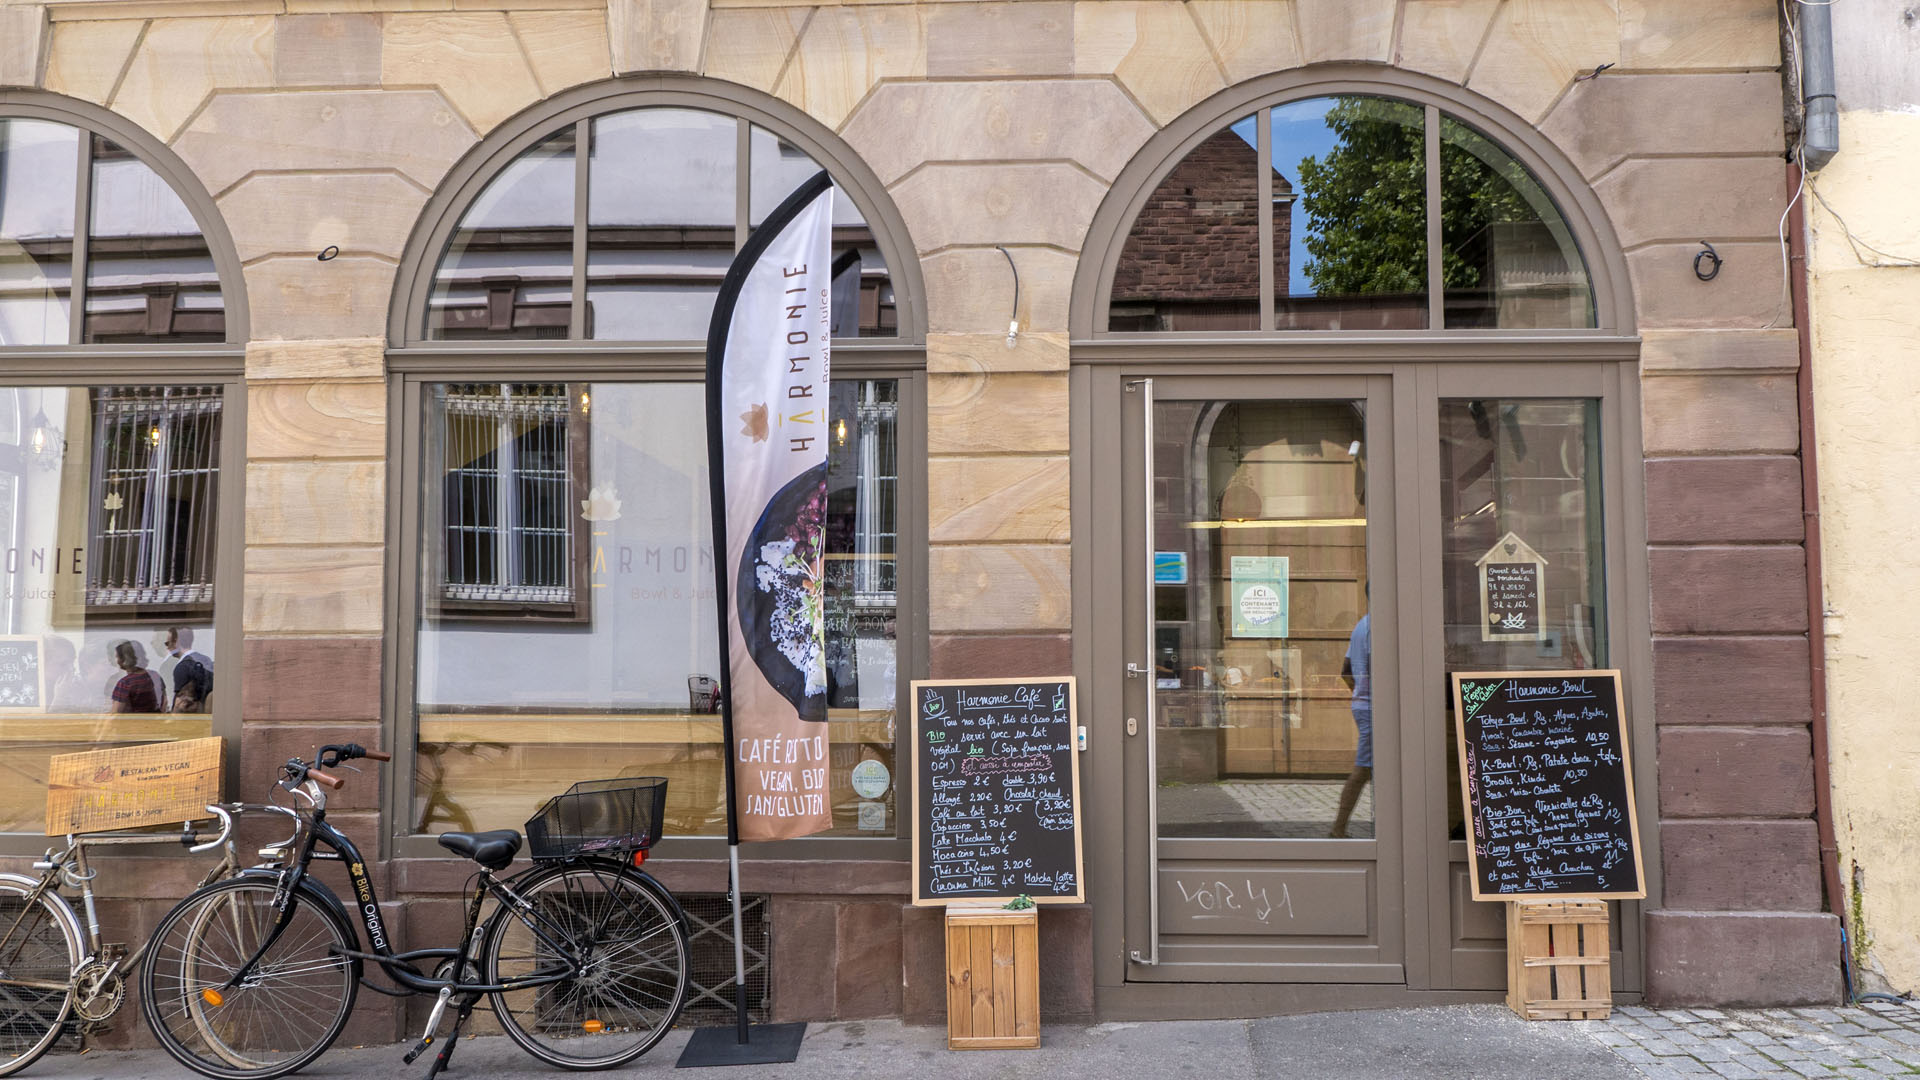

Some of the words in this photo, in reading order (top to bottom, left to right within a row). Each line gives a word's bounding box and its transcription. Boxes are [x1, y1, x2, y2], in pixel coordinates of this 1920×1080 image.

[820, 289, 829, 325] Juice
[782, 264, 816, 452] HARMONIE
[22, 587, 57, 600] Juice
[631, 587, 667, 600] Bowl
[1253, 589, 1266, 597] ICI
[863, 616, 888, 632] BON
[1461, 682, 1475, 693] Bio
[1505, 680, 1560, 700] Harmonie
[1561, 679, 1593, 696] Bowl
[956, 689, 1012, 716] Harmonie
[1015, 686, 1042, 711] Café
[939, 716, 957, 727] Tous
[1020, 715, 1028, 724] et
[1476, 714, 1504, 729] Tokyo
[960, 731, 986, 742] servis
[990, 730, 1011, 738] avec
[1031, 726, 1048, 737] lait
[739, 733, 782, 763] CAFÉ
[930, 744, 961, 760] végétal
[967, 743, 984, 755] bio
[1541, 753, 1569, 767] Patate
[120, 765, 161, 777] RESTAURANT
[164, 762, 190, 772] VEGAN
[802, 768, 824, 790] BIO
[932, 776, 967, 792] Espresso
[1002, 774, 1025, 785] double
[85, 786, 176, 811] HARMONIE
[932, 792, 962, 806] Allongé
[1003, 788, 1039, 801] Chocolat
[1534, 798, 1578, 813] Vermicelles
[932, 806, 951, 824] Café
[970, 805, 985, 817] lait
[1486, 840, 1511, 859] Curry
[1570, 832, 1582, 841] de
[930, 864, 952, 877] Thés
[1496, 859, 1517, 868] avec
[973, 875, 995, 888] Milk
[1023, 872, 1053, 884] Matcha
[1488, 870, 1498, 881] et
[1524, 879, 1536, 888] du
[1597, 876, 1605, 885] 5
[356, 877, 370, 902] Bike
[364, 903, 387, 949] Original
